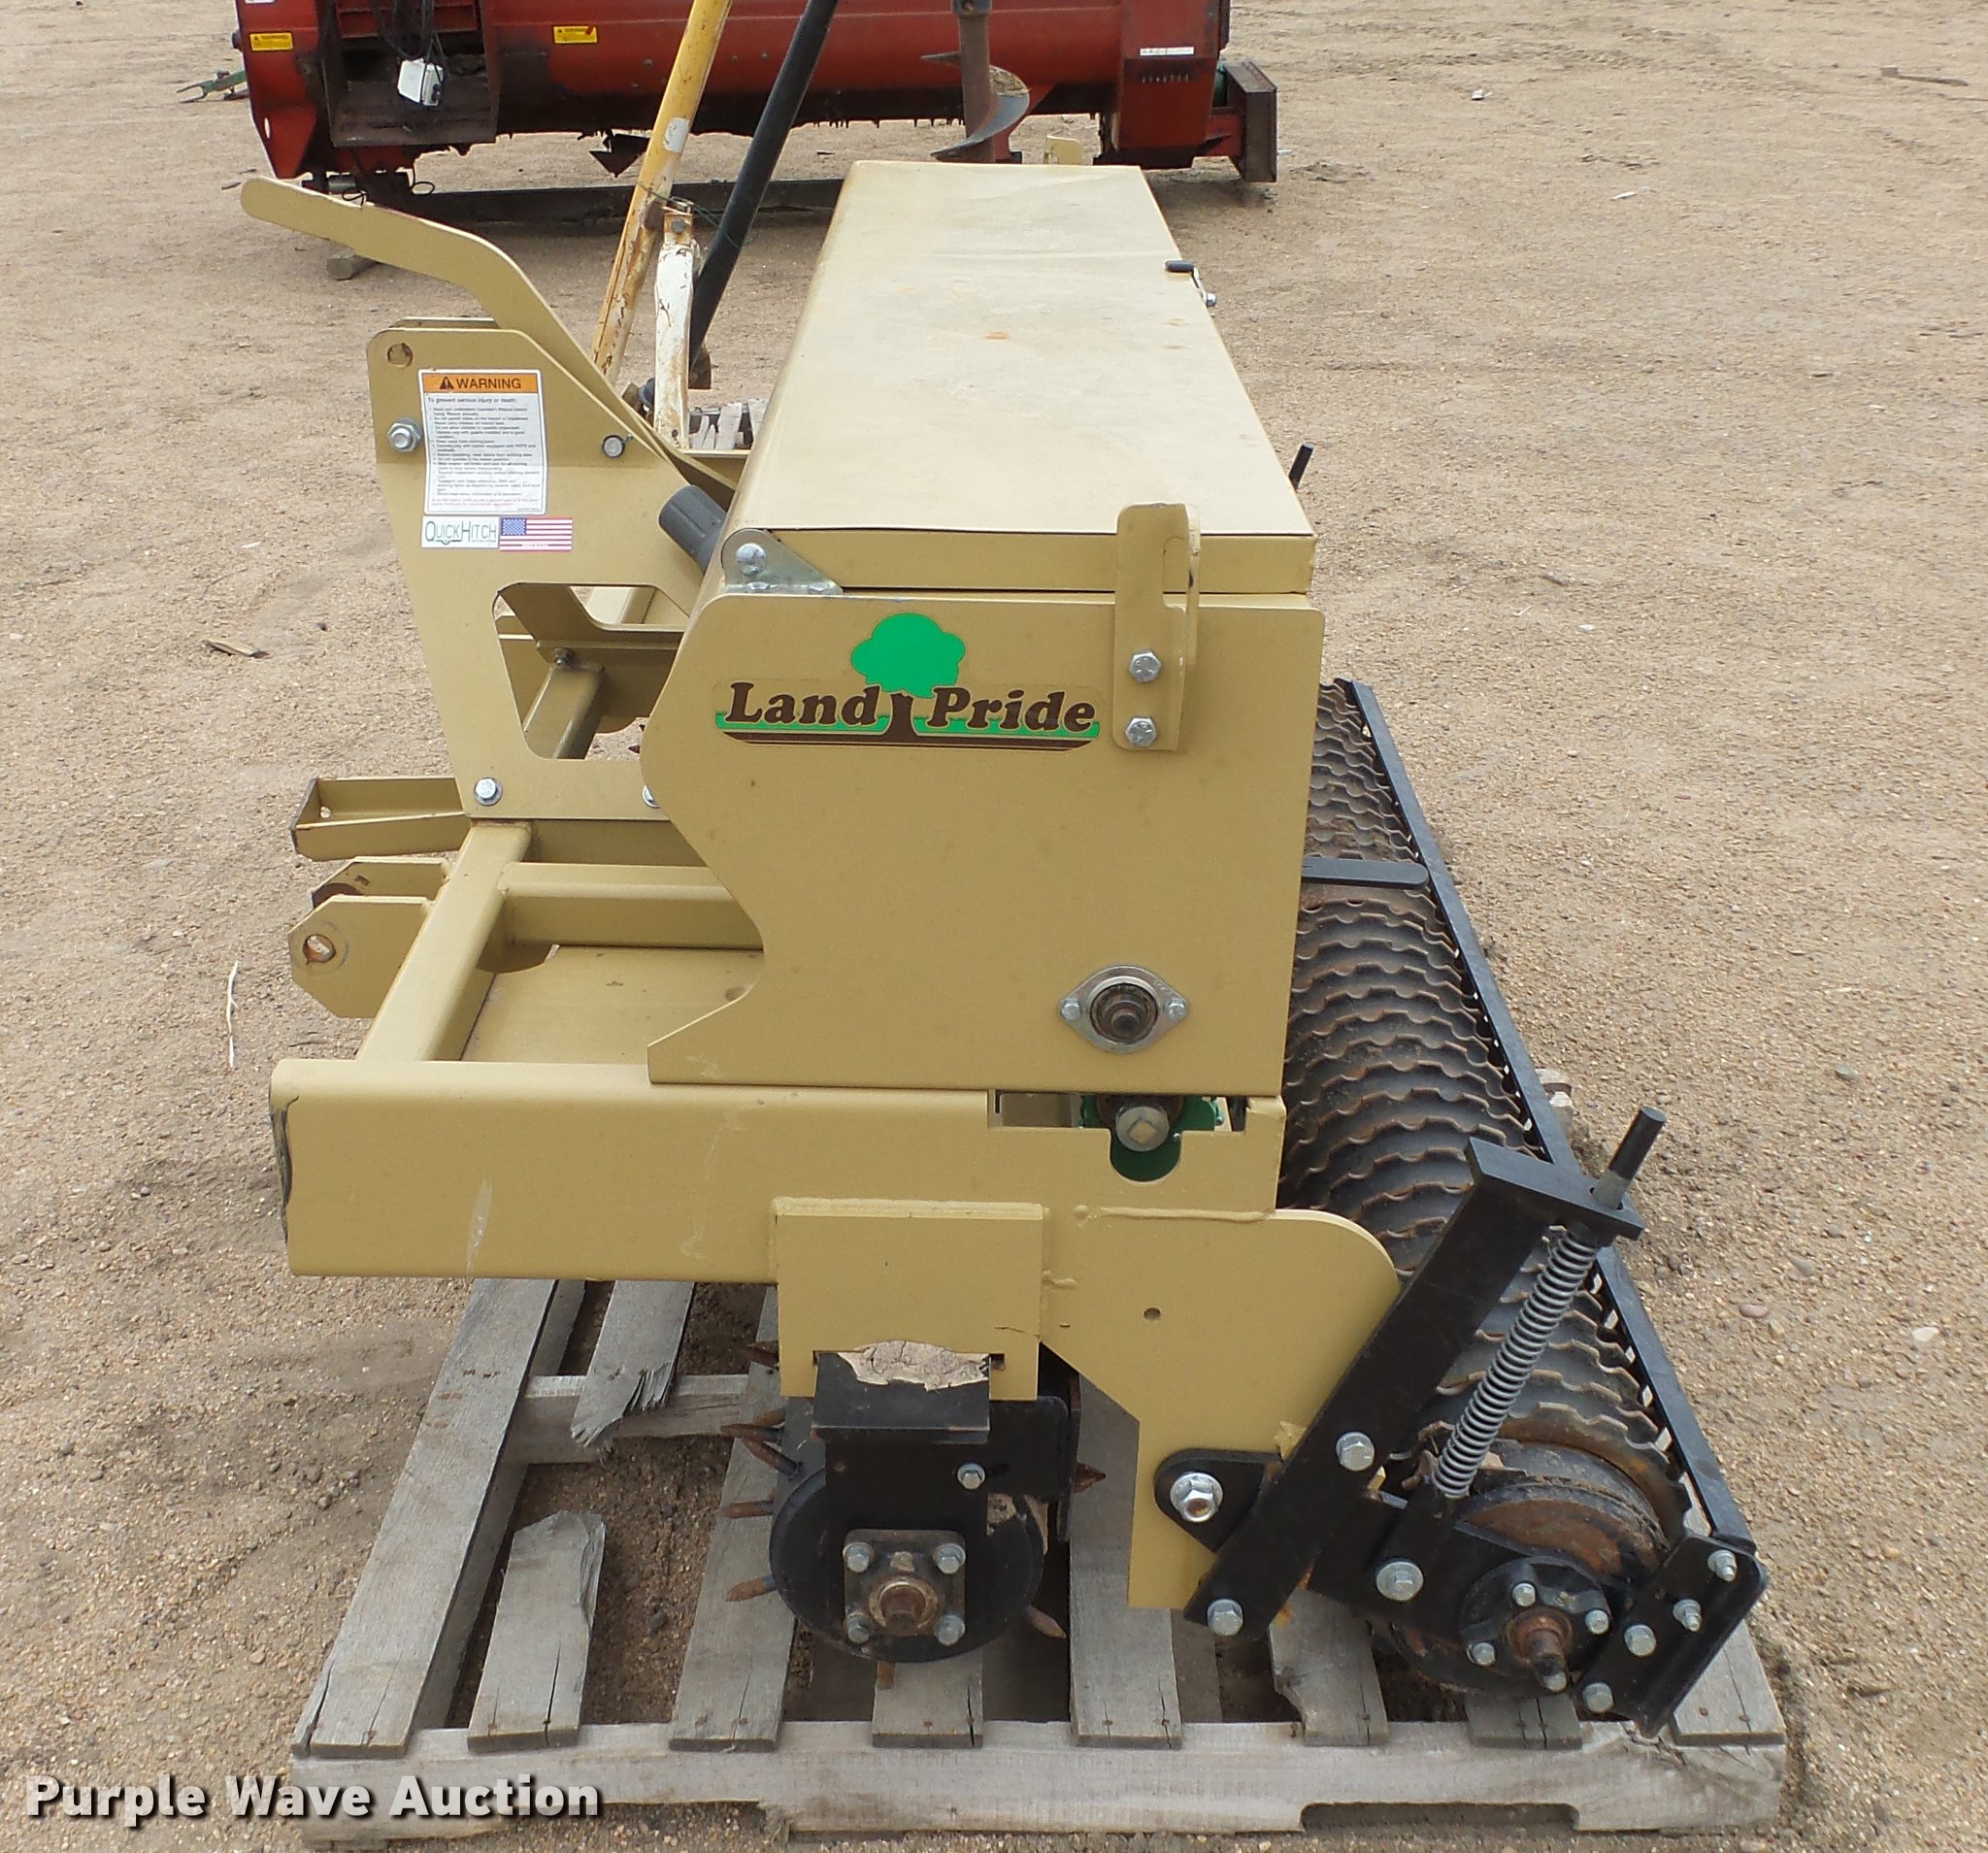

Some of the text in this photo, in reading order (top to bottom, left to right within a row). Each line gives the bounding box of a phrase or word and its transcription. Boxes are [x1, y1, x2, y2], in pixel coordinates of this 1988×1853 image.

[456, 378, 521, 389] WARNING
[725, 681, 1096, 733] Land Pride
